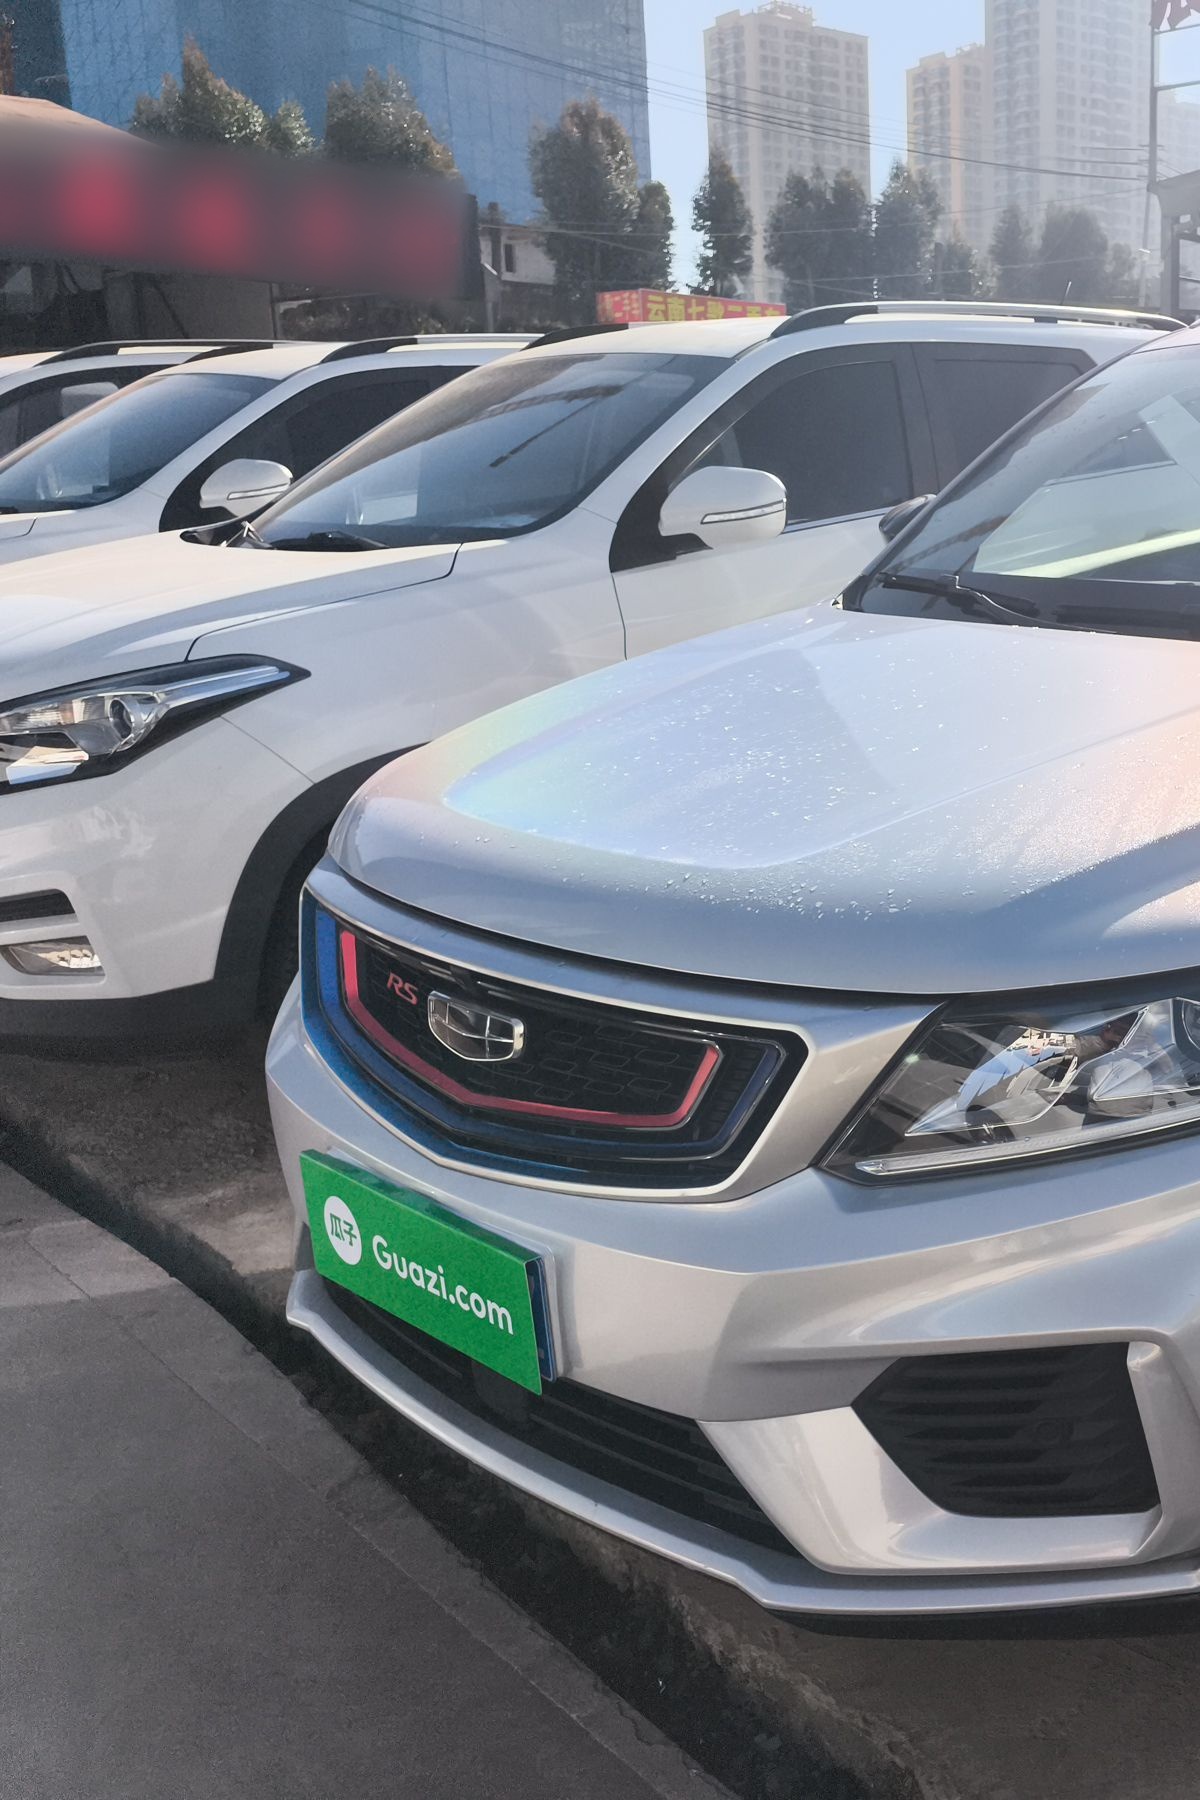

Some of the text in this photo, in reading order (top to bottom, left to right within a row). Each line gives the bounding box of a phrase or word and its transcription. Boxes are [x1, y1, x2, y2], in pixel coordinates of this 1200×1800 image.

[387, 972, 418, 1005] RS
[329, 1212, 357, 1247] 瓜子
[372, 1234, 514, 1335] Guazi.com
